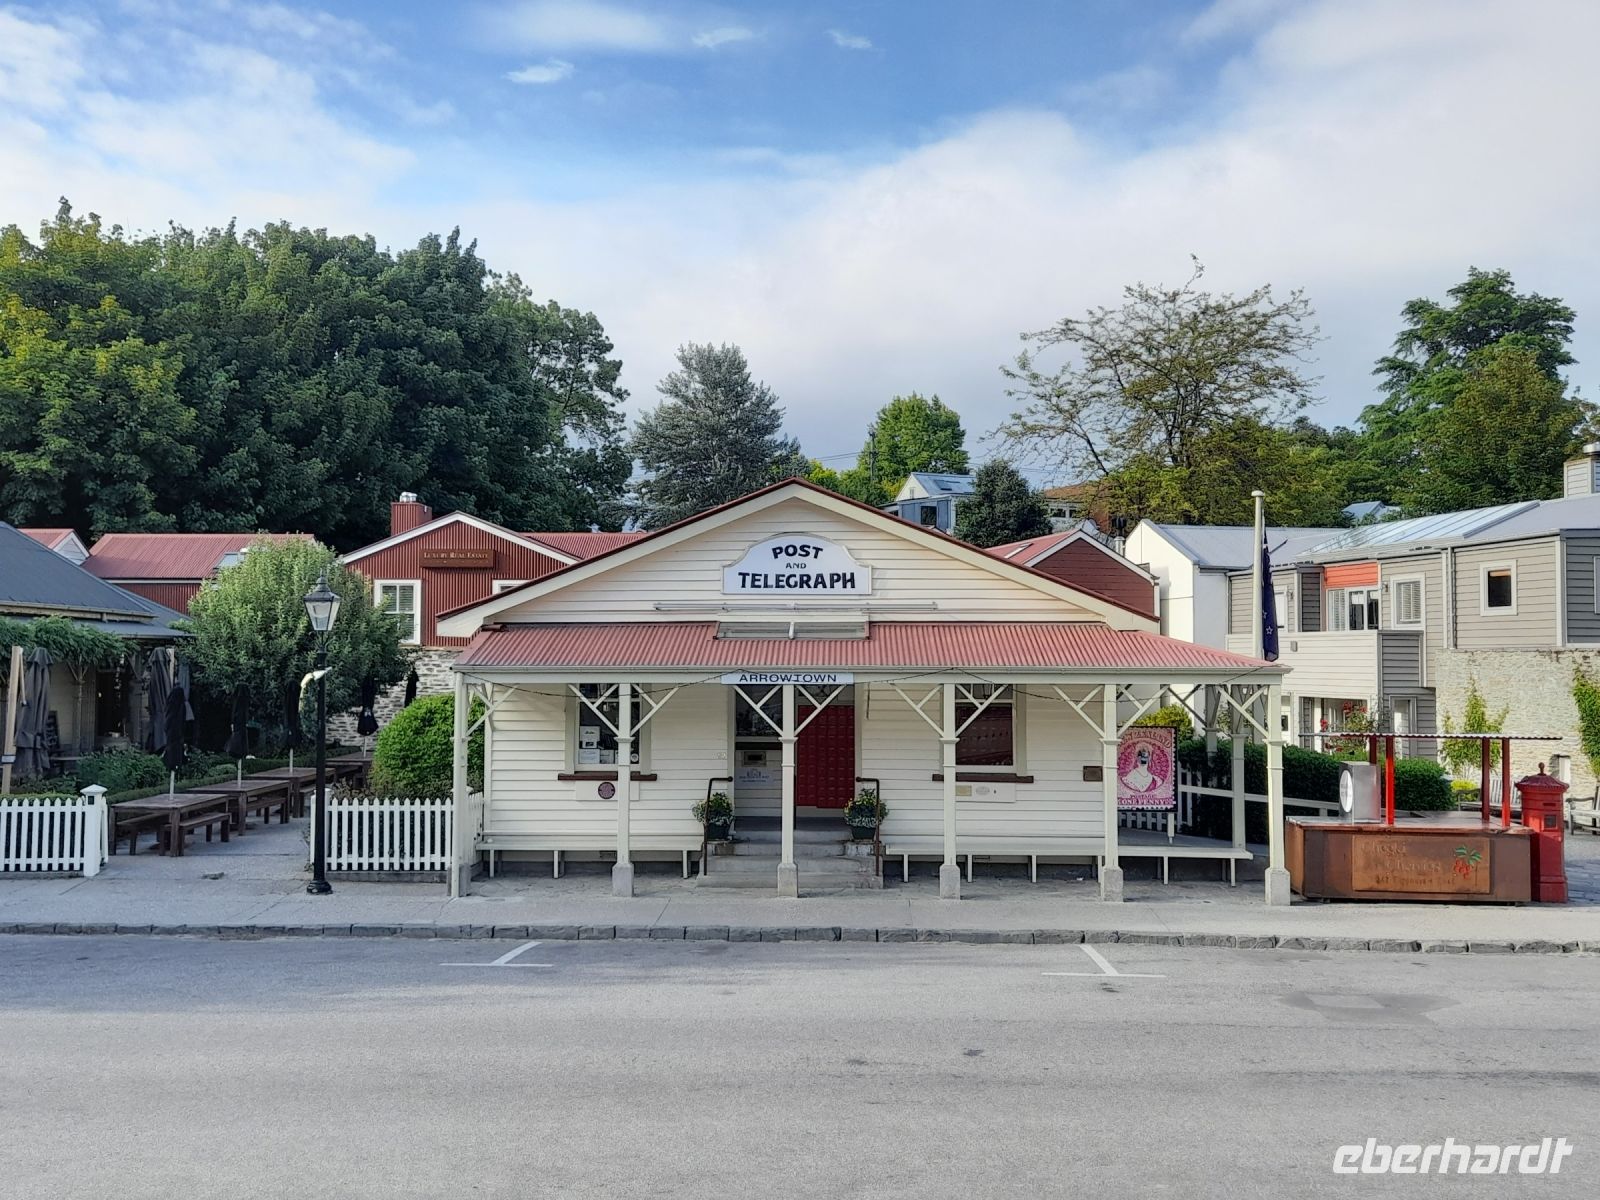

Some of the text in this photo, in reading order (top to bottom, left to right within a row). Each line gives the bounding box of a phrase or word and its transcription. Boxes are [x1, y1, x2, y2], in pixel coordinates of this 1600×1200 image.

[771, 544, 824, 560] POST
[785, 562, 807, 570] AND
[738, 572, 856, 589] TELEGRAPH
[739, 674, 837, 683] ARROWTOWN
